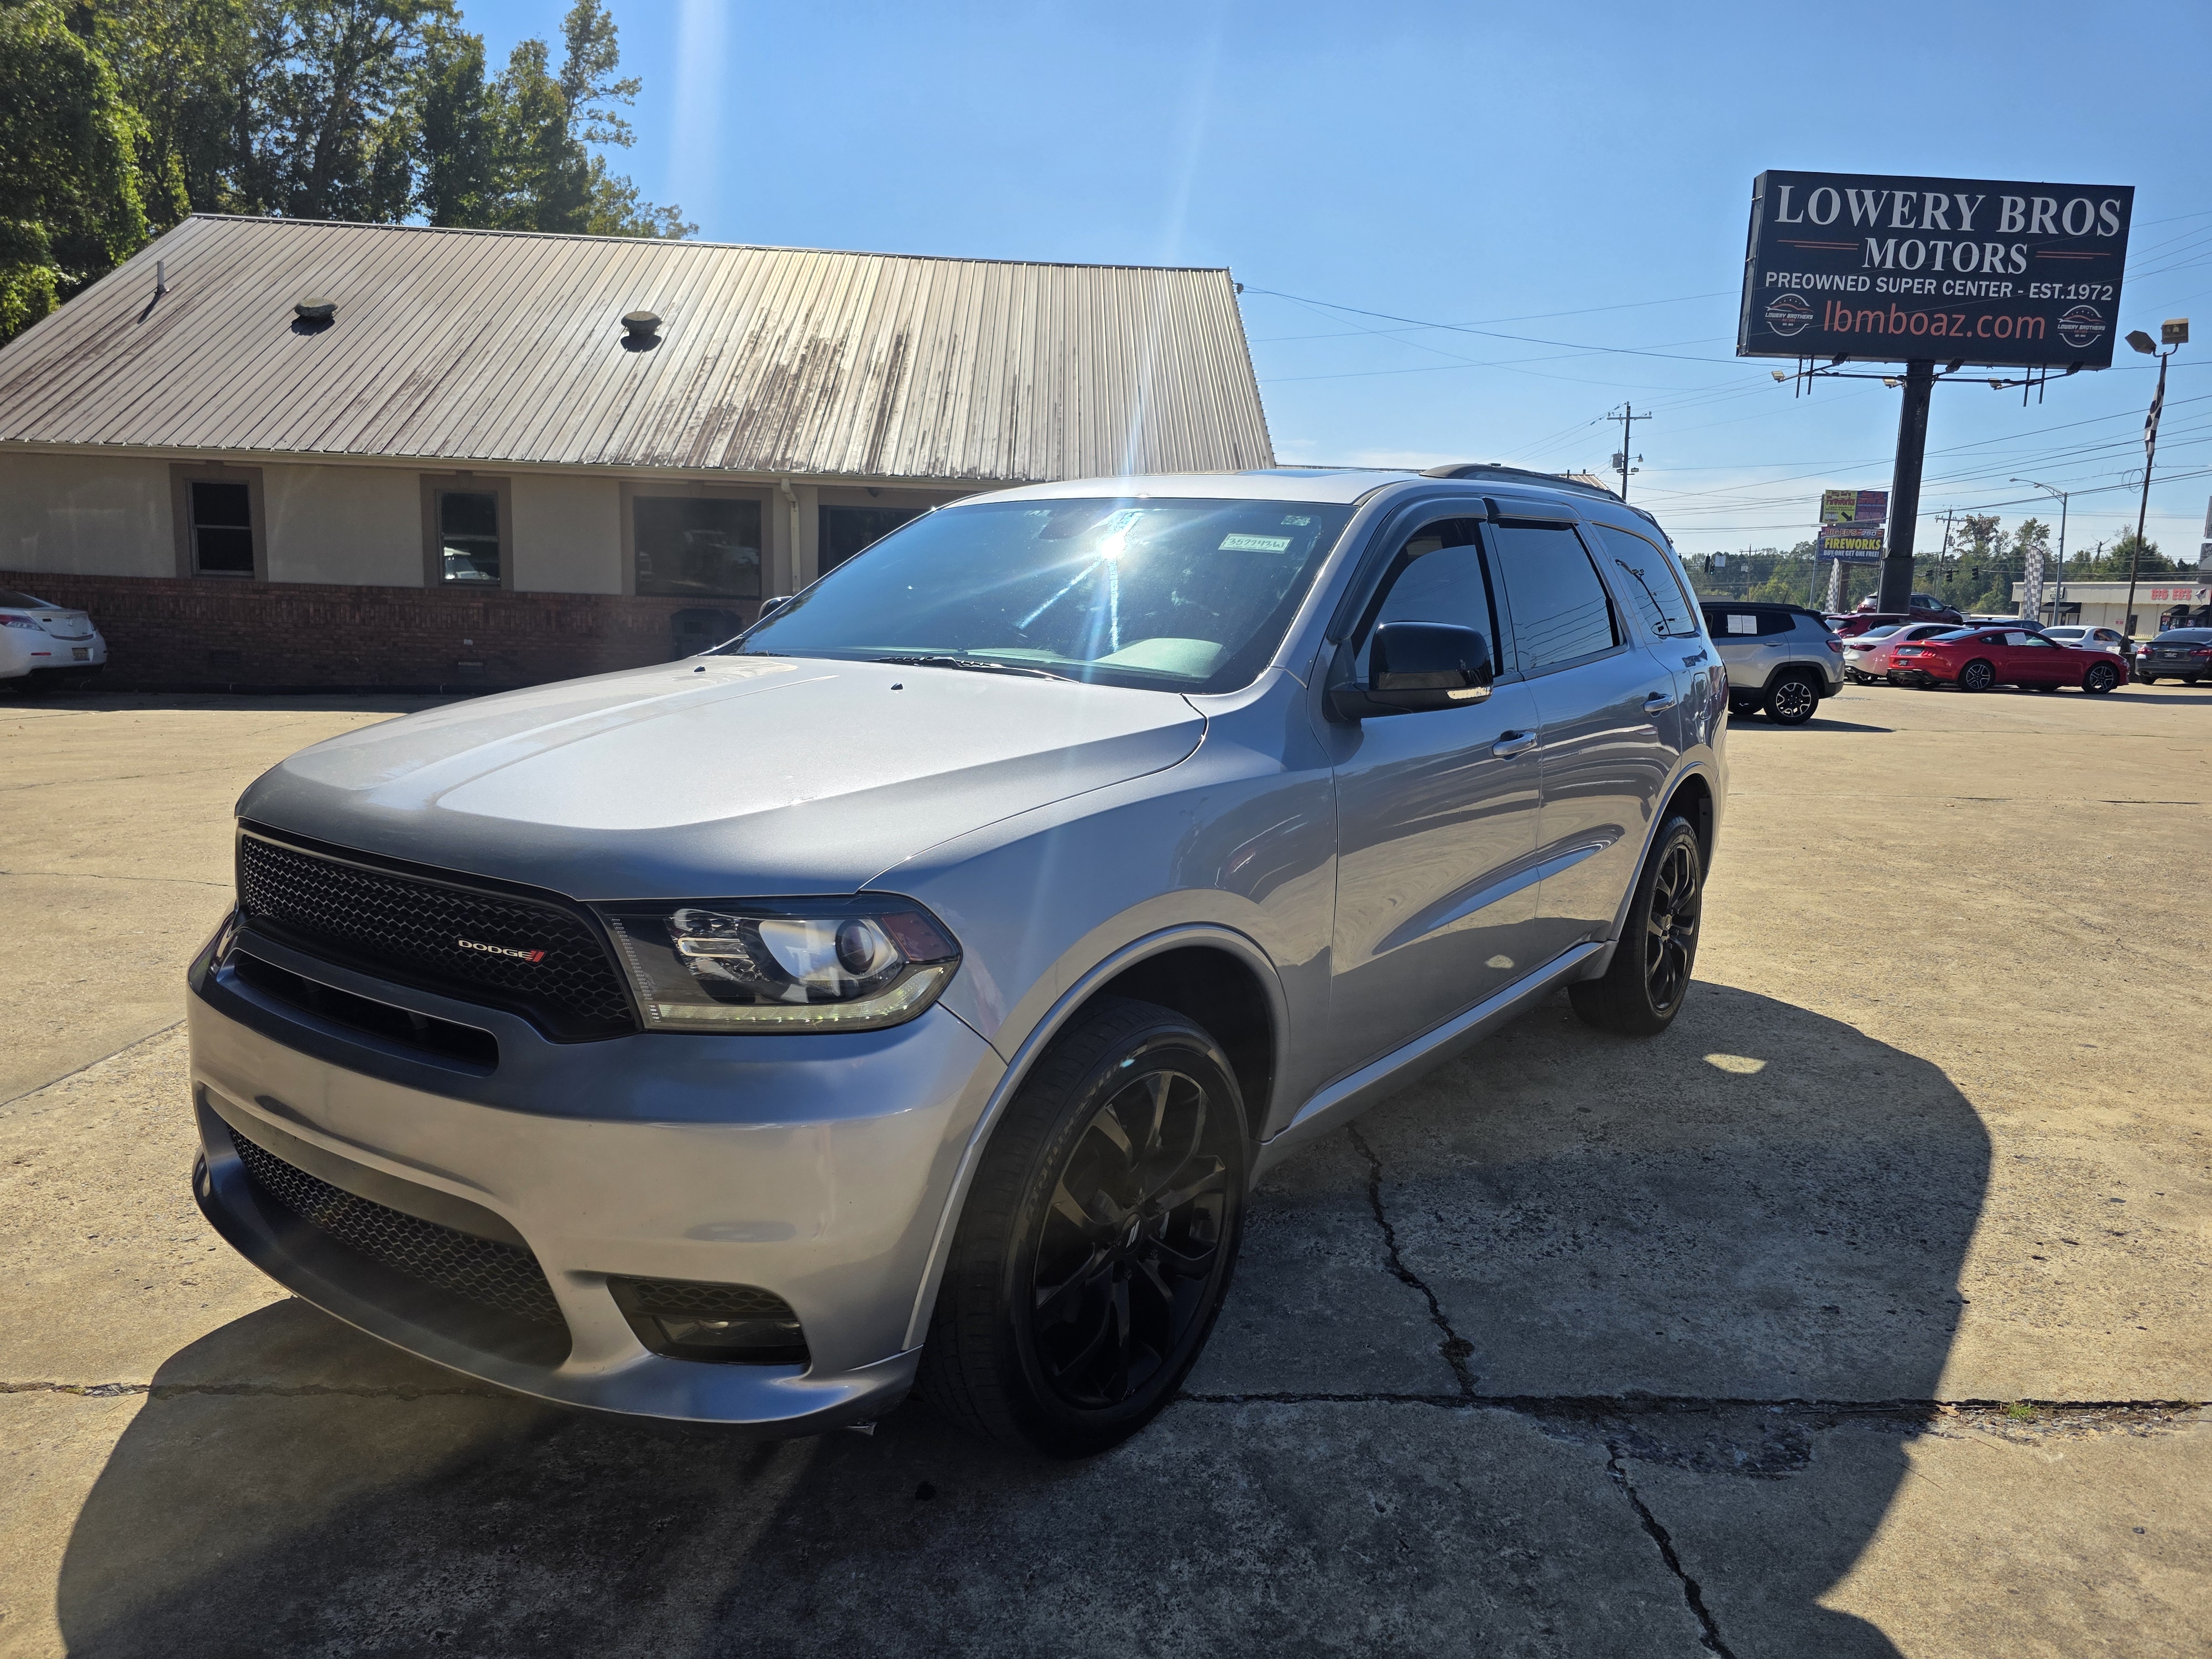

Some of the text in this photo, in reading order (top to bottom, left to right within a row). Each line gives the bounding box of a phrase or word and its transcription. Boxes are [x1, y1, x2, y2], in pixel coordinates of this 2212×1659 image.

[1774, 185, 2121, 237] LOWERY BROS
[1861, 237, 2028, 275] MOTORS
[1765, 272, 1870, 292] PREOWNED
[1875, 276, 1937, 295] SUPER
[1942, 279, 2013, 298] CENTER
[2029, 283, 2114, 301] EST.1972
[1824, 300, 2046, 339] lbmboaz.com
[1824, 538, 1881, 550] FIREWORKS
[2151, 588, 2193, 601] BIG ED'S
[458, 939, 534, 960] DODGE
